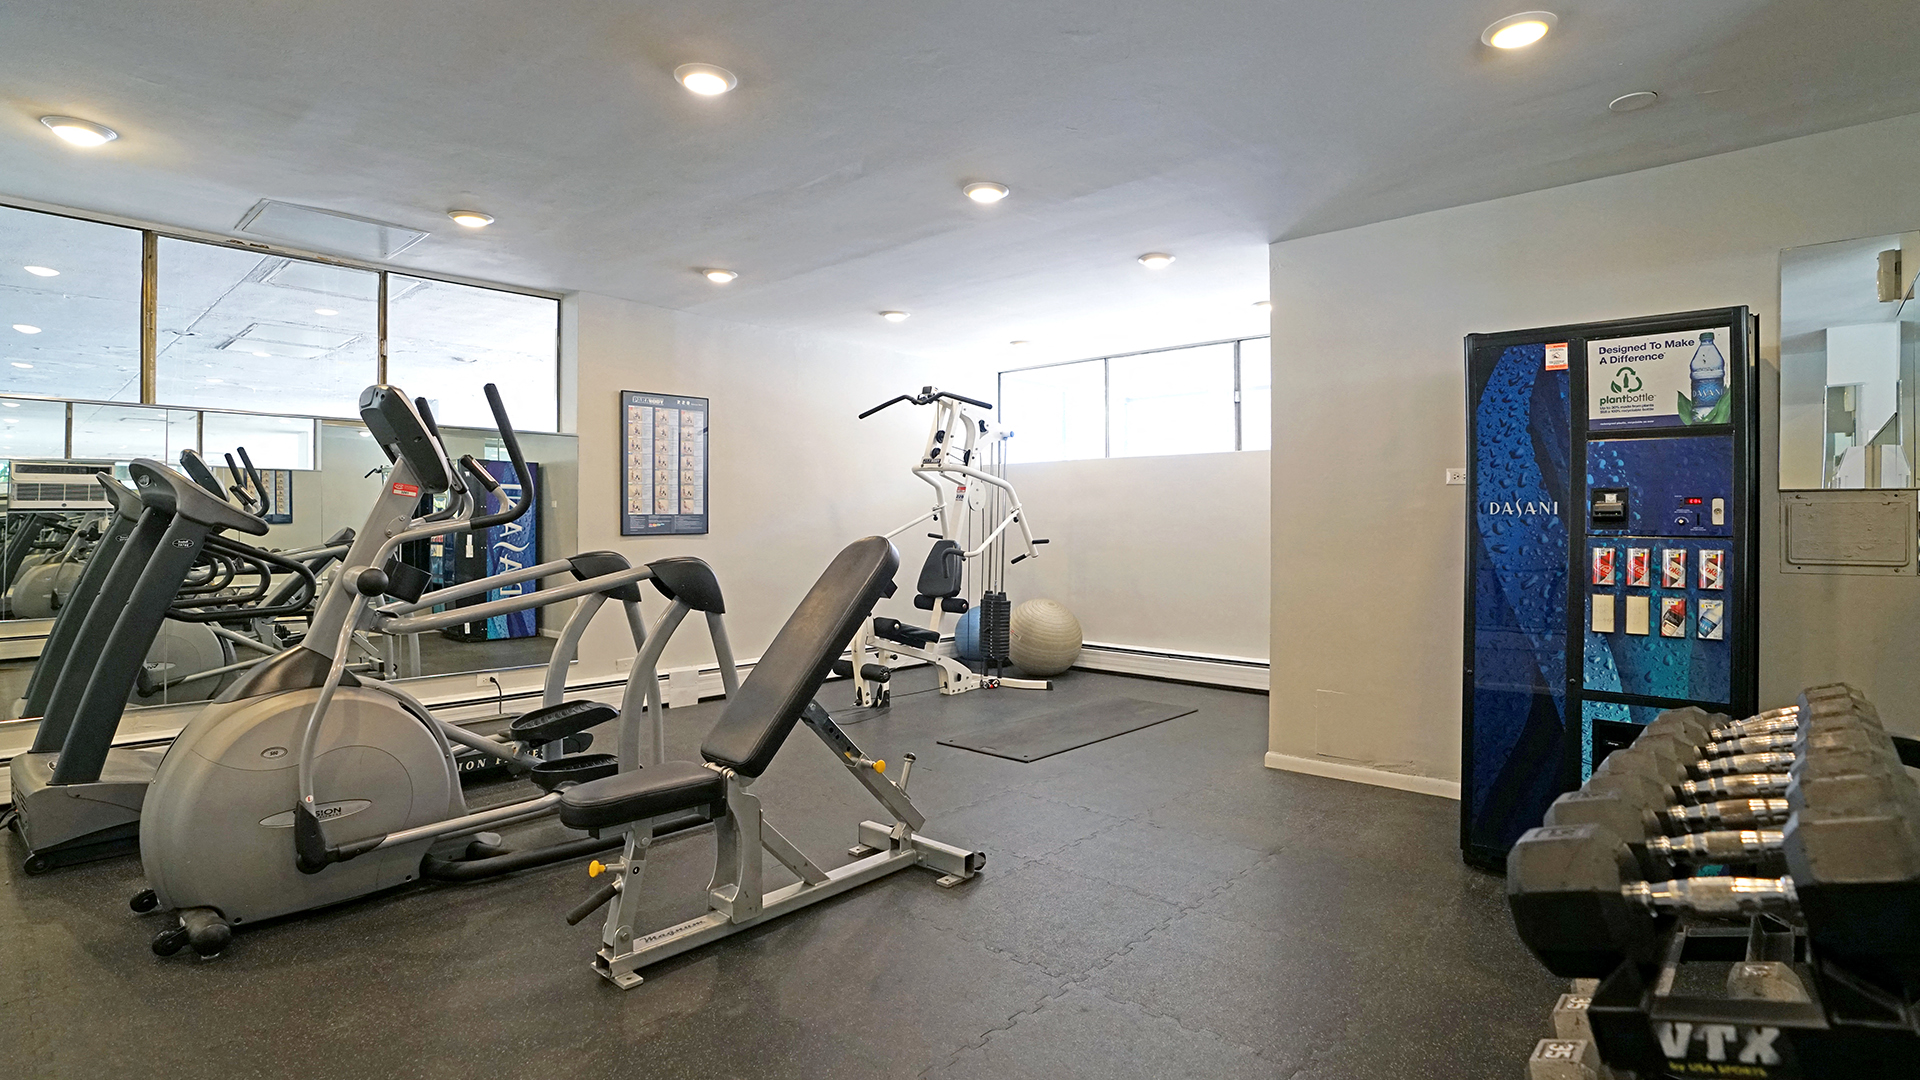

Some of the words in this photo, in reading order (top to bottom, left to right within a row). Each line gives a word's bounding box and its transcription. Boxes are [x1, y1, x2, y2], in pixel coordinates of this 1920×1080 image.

[1599, 343, 1647, 355] Designed
[1649, 341, 1662, 350] To
[1664, 339, 1695, 349] Make
[1599, 357, 1608, 365] A
[1609, 353, 1665, 364] Difference
[1600, 393, 1655, 406] plantbottle
[1489, 498, 1559, 519] DASANI
[458, 758, 487, 772] ION
[639, 920, 706, 943] Magnum
[1545, 1043, 1574, 1058] 35
[1657, 1021, 1782, 1066] VTX
